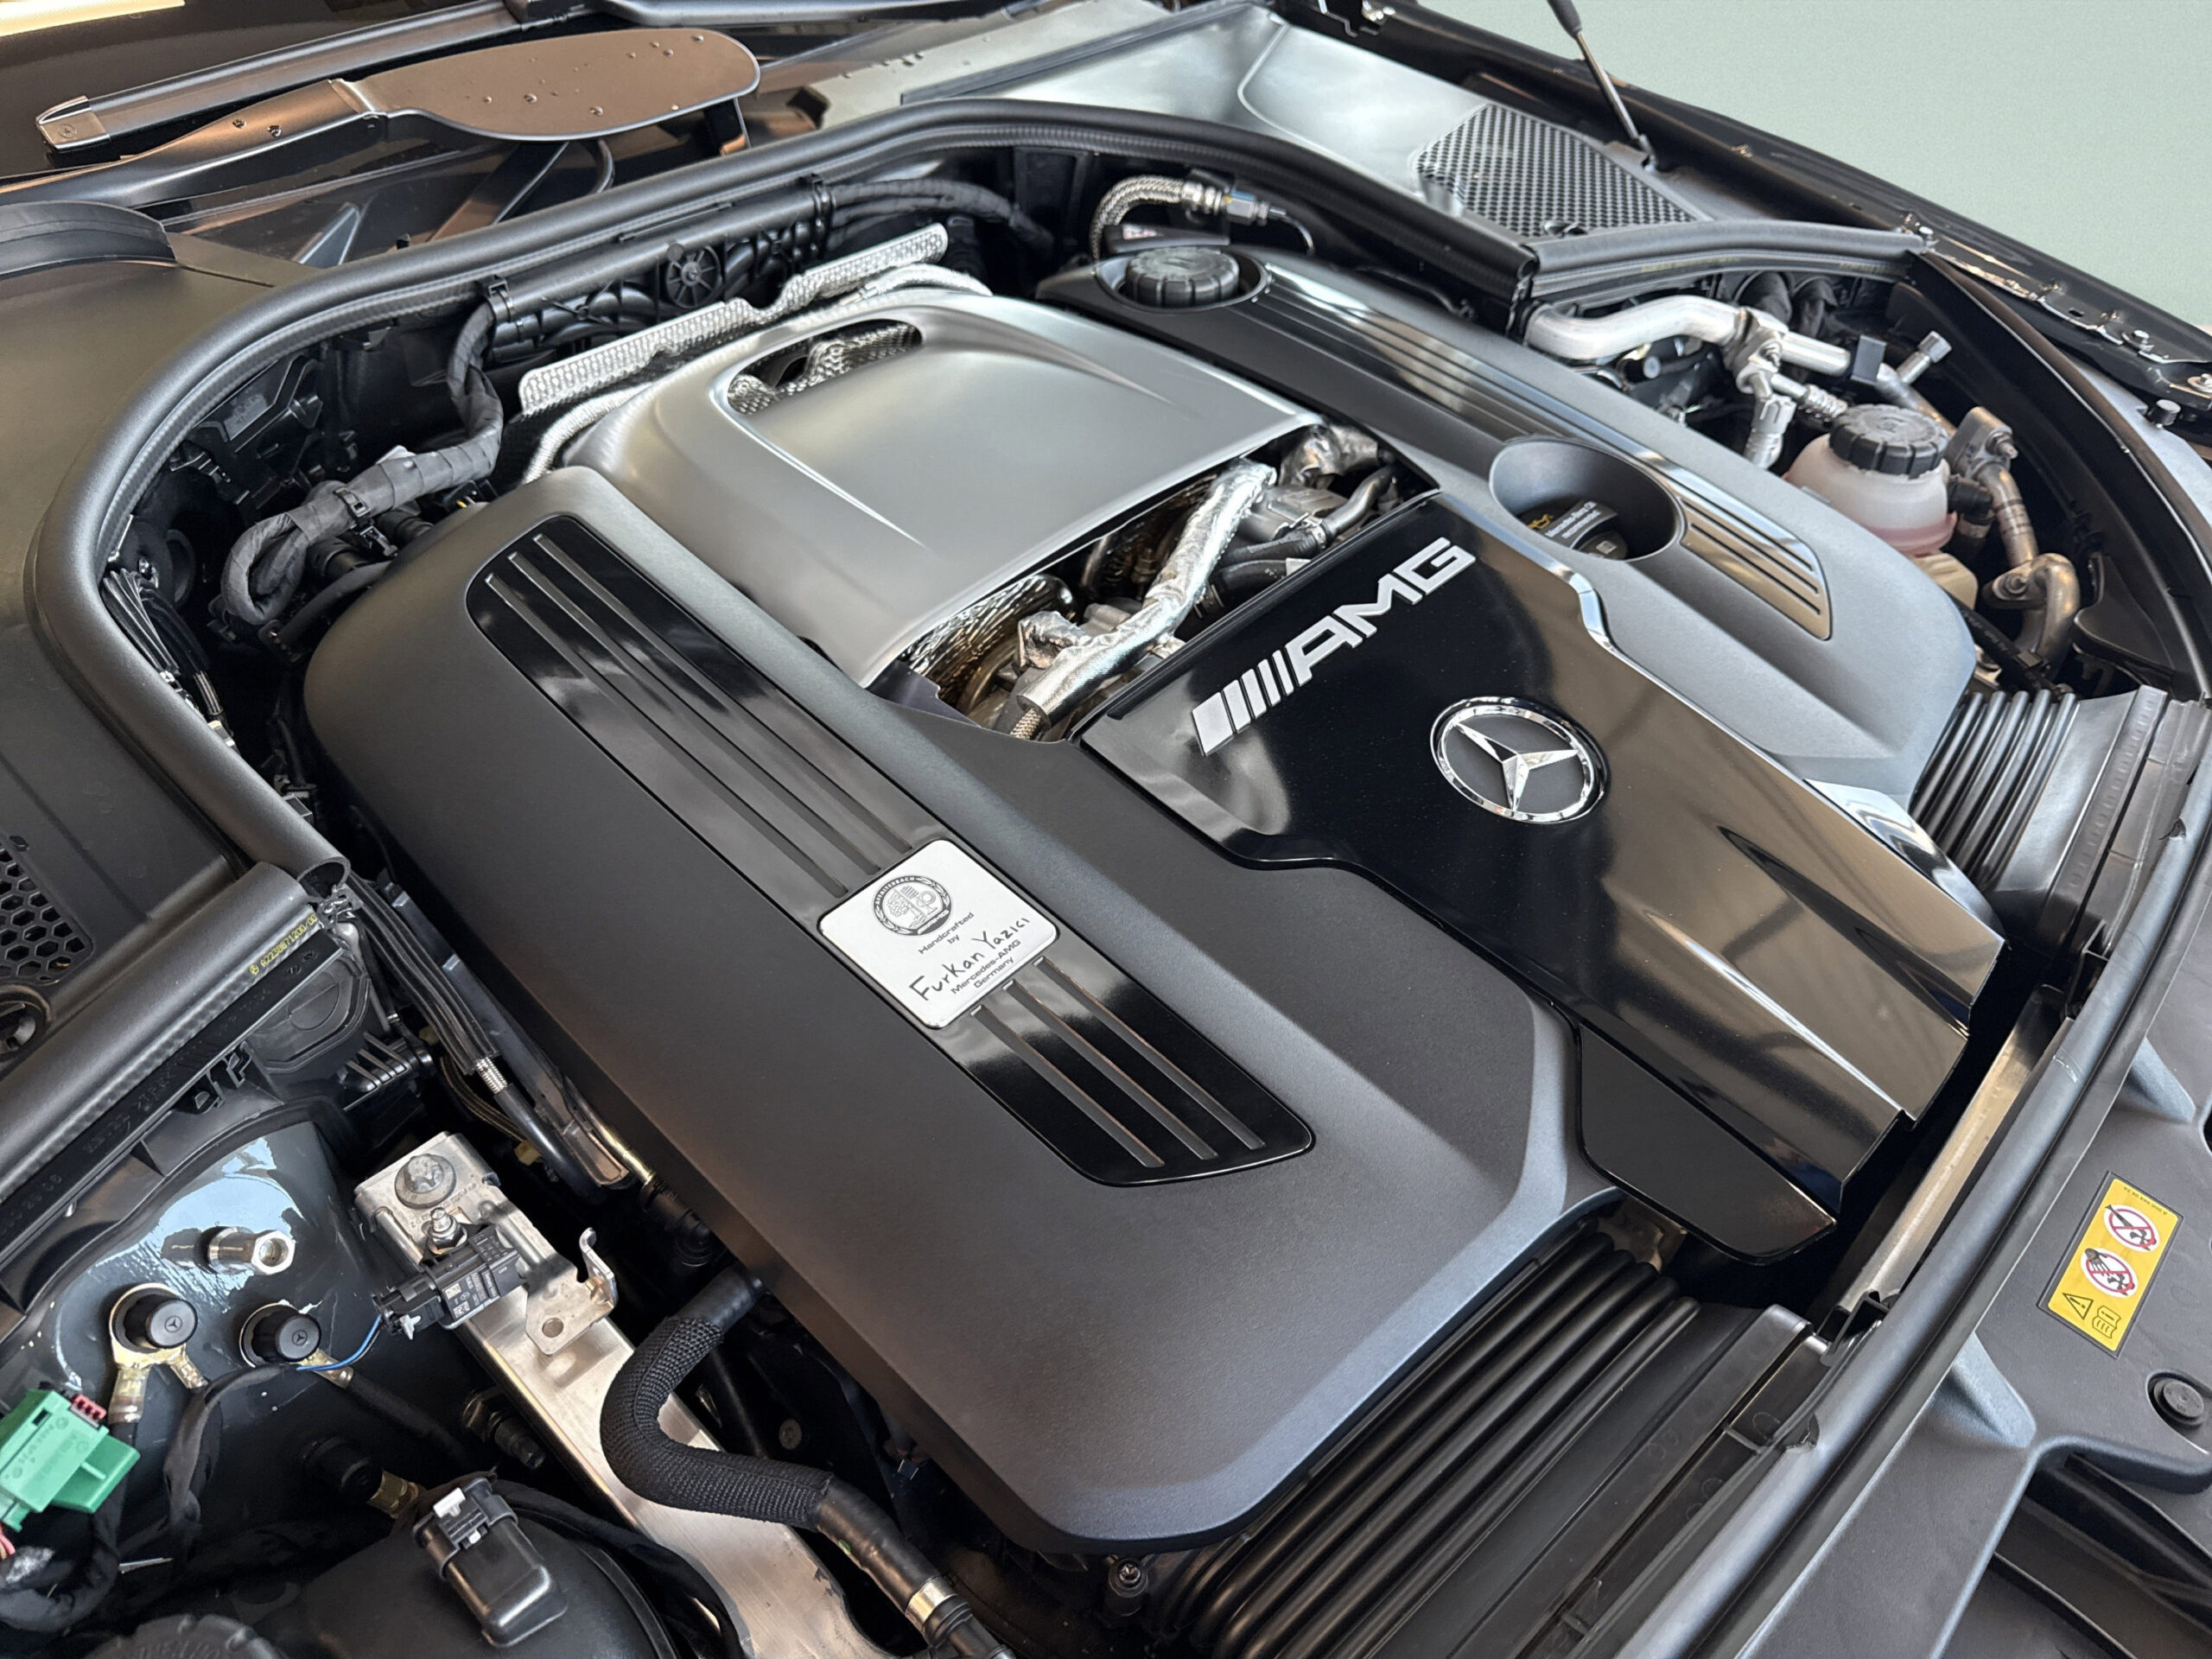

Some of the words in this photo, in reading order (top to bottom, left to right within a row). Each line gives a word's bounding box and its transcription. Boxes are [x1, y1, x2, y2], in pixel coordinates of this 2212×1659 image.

[1285, 537, 1476, 687] AMG
[918, 912, 975, 954] Handcrafted
[947, 934, 960, 944] by
[950, 939, 1021, 994] Mercedes-AMG
[974, 957, 1014, 988] Germany
